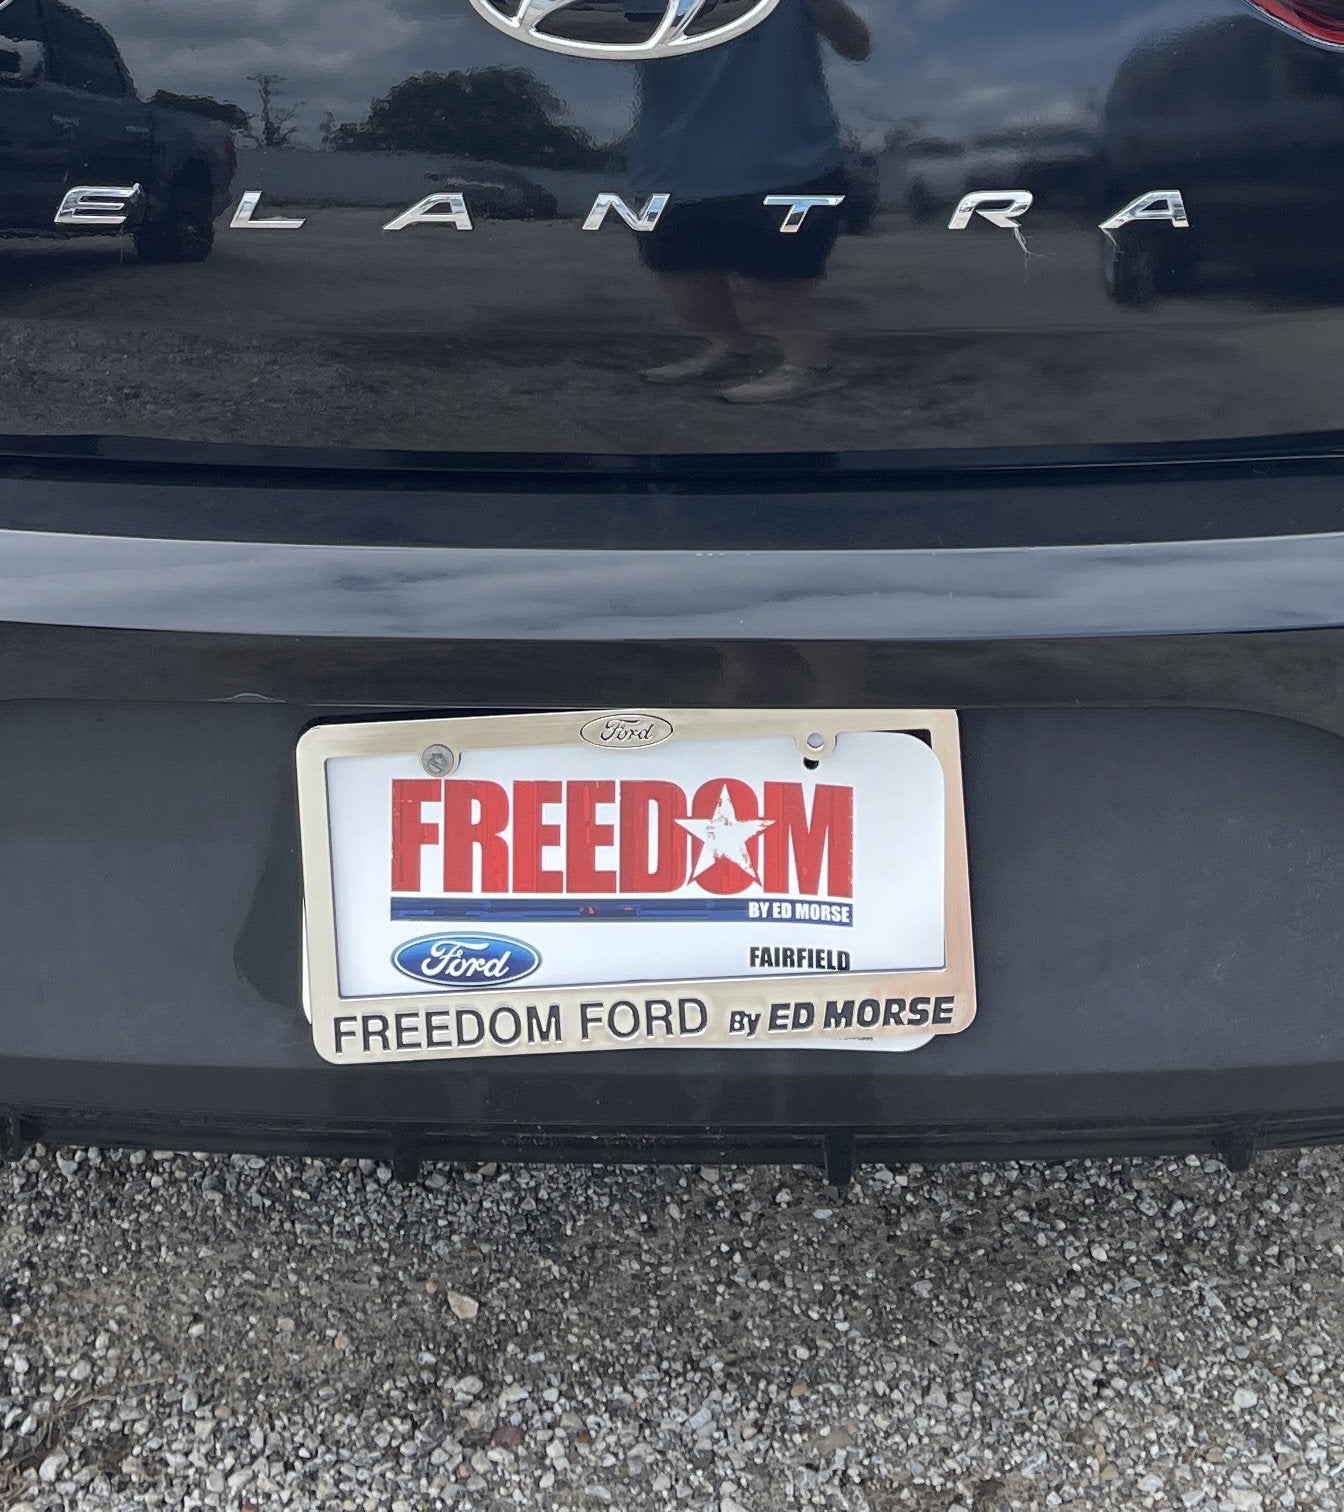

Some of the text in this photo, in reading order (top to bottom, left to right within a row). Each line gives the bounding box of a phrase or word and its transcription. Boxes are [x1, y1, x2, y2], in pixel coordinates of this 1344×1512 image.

[54, 185, 1189, 233] ELANTRA
[600, 718, 655, 742] Ford
[391, 777, 854, 899] FREEDOM
[748, 901, 850, 923] BY ED MORSE
[421, 940, 511, 979] Ford
[749, 946, 851, 972] FAIRFIELD
[333, 1003, 563, 1054] FREEDOM
[579, 998, 710, 1040] FORD
[767, 1001, 816, 1033] ED
[822, 995, 956, 1030] MORSE
